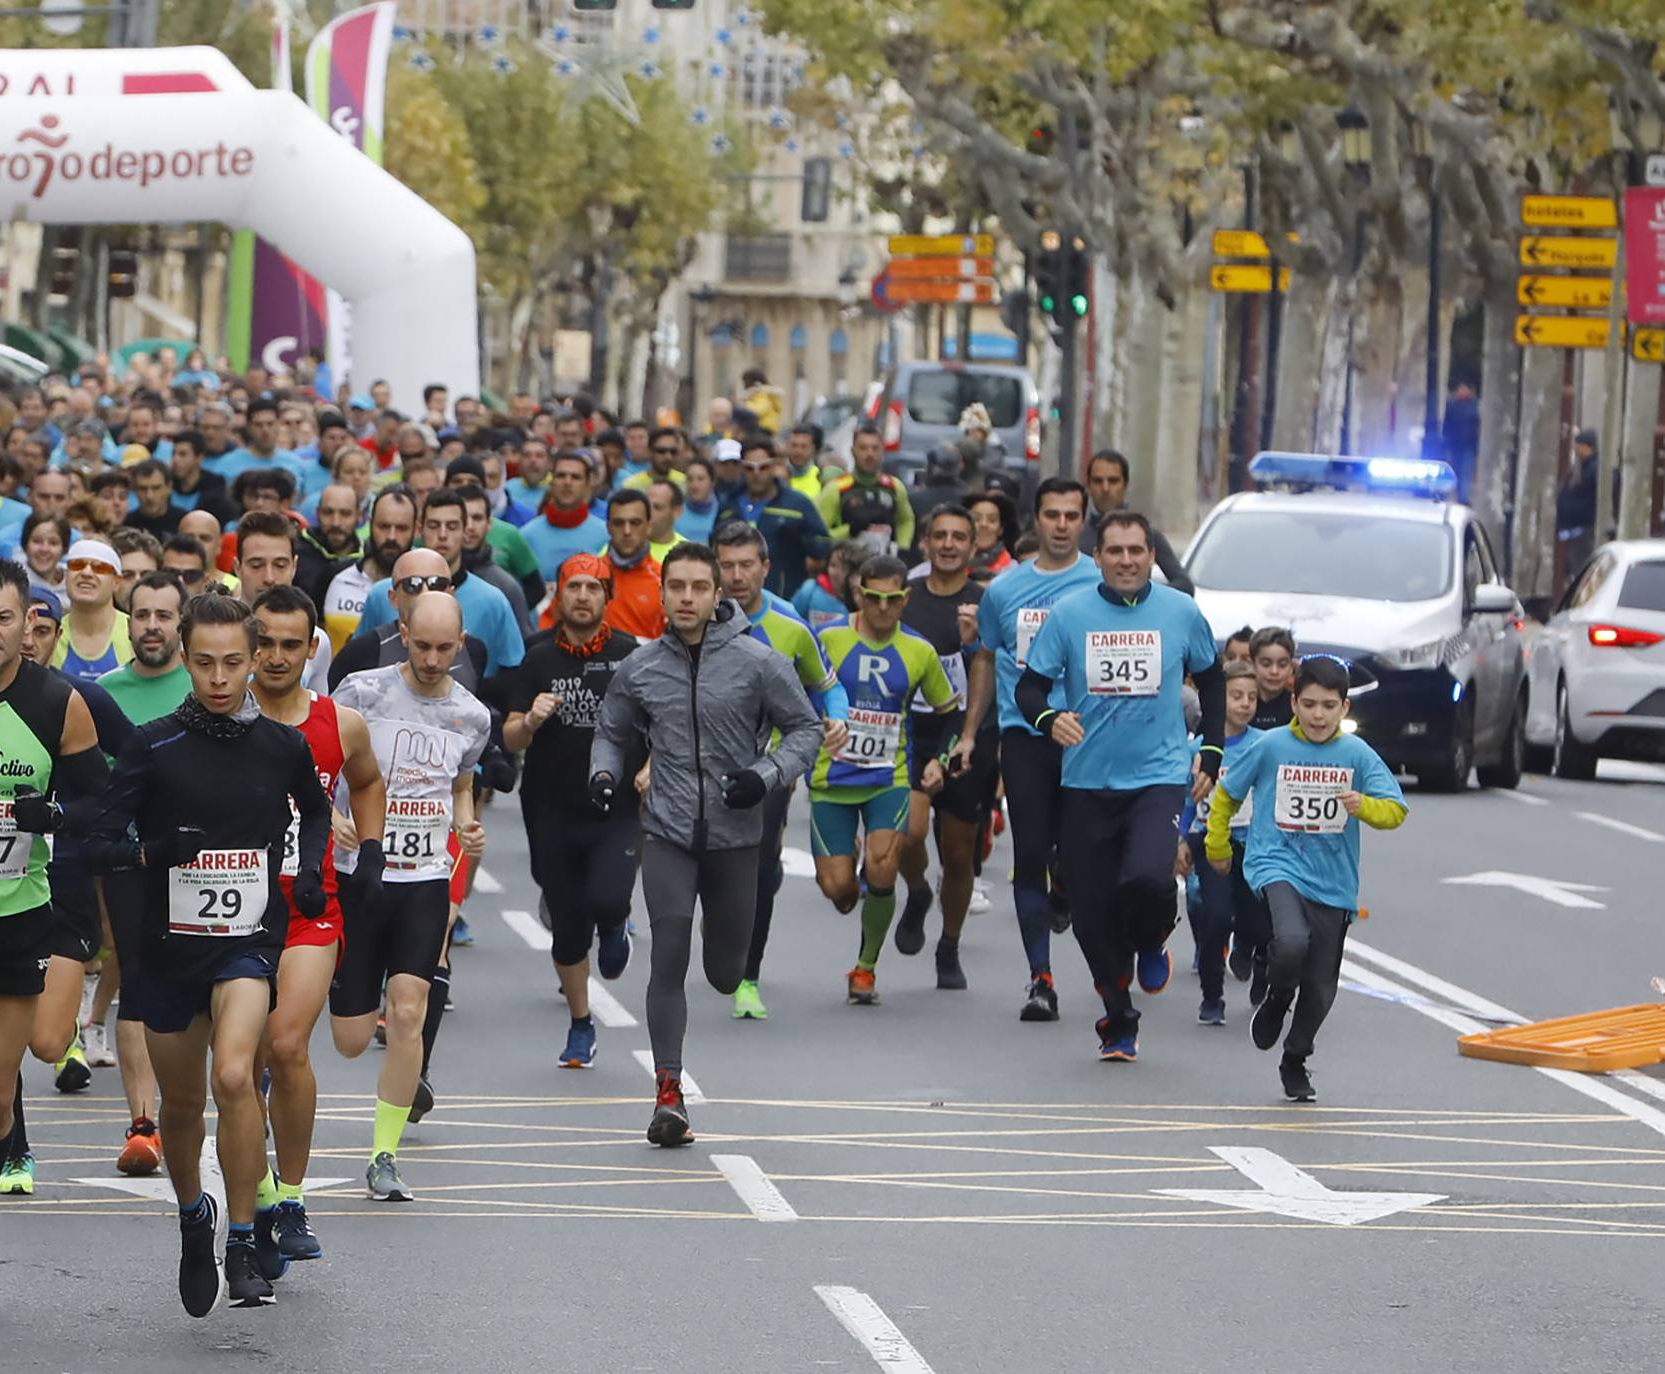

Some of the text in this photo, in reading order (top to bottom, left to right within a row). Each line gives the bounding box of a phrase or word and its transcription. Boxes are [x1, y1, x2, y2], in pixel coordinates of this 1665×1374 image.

[89, 140, 255, 188] deporte
[1091, 632, 1156, 648] CARRERA
[1099, 659, 1149, 682] 345
[550, 676, 582, 692] 2019
[845, 734, 887, 758] 101
[1283, 767, 1348, 784] CARRERA
[1288, 795, 1339, 820] 350
[384, 830, 435, 859] 181
[197, 887, 243, 919] 29
